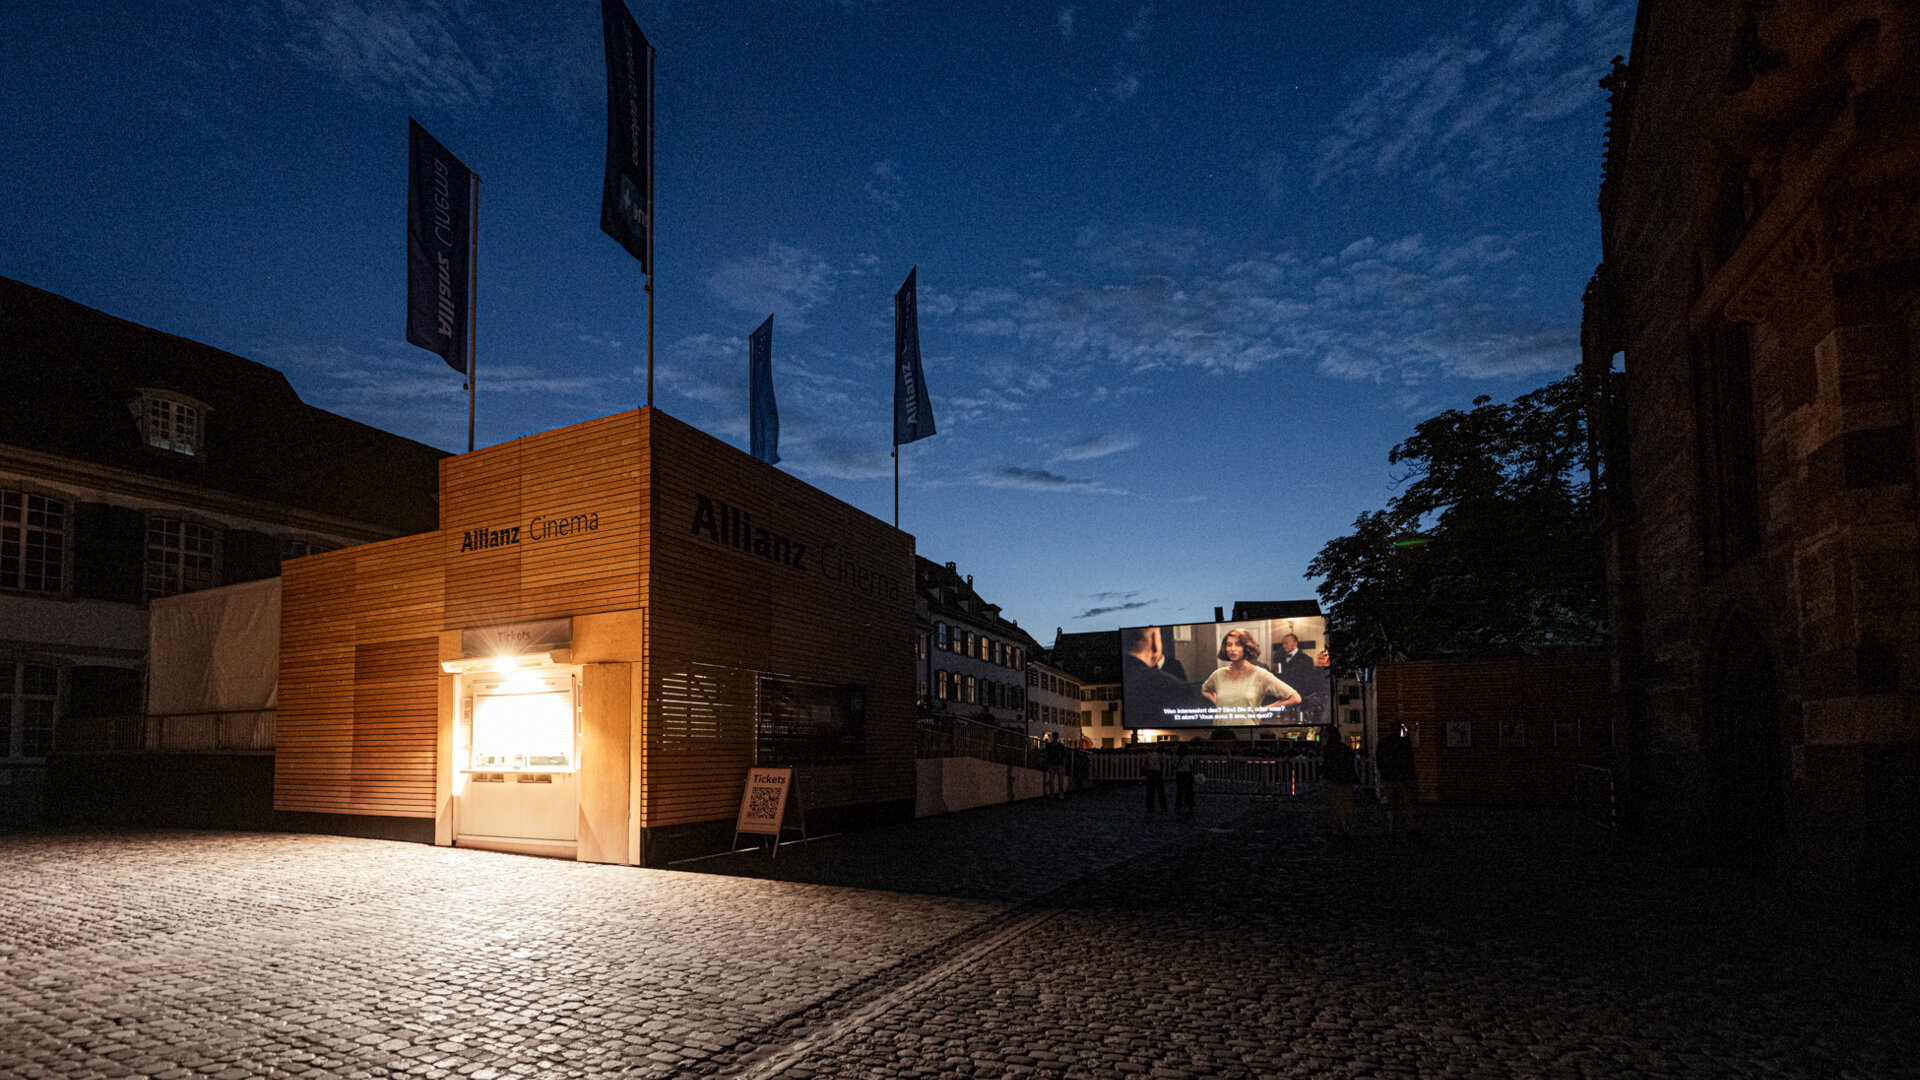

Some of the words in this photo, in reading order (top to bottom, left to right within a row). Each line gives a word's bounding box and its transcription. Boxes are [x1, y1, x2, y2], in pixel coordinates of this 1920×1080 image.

[901, 361, 918, 425] Allianz
[461, 526, 521, 553] Allianz
[529, 511, 600, 541] Cinema
[691, 493, 807, 572] Allianz
[820, 543, 899, 601] Cinema
[497, 627, 532, 642] Tickets
[753, 774, 787, 785] Tickets
